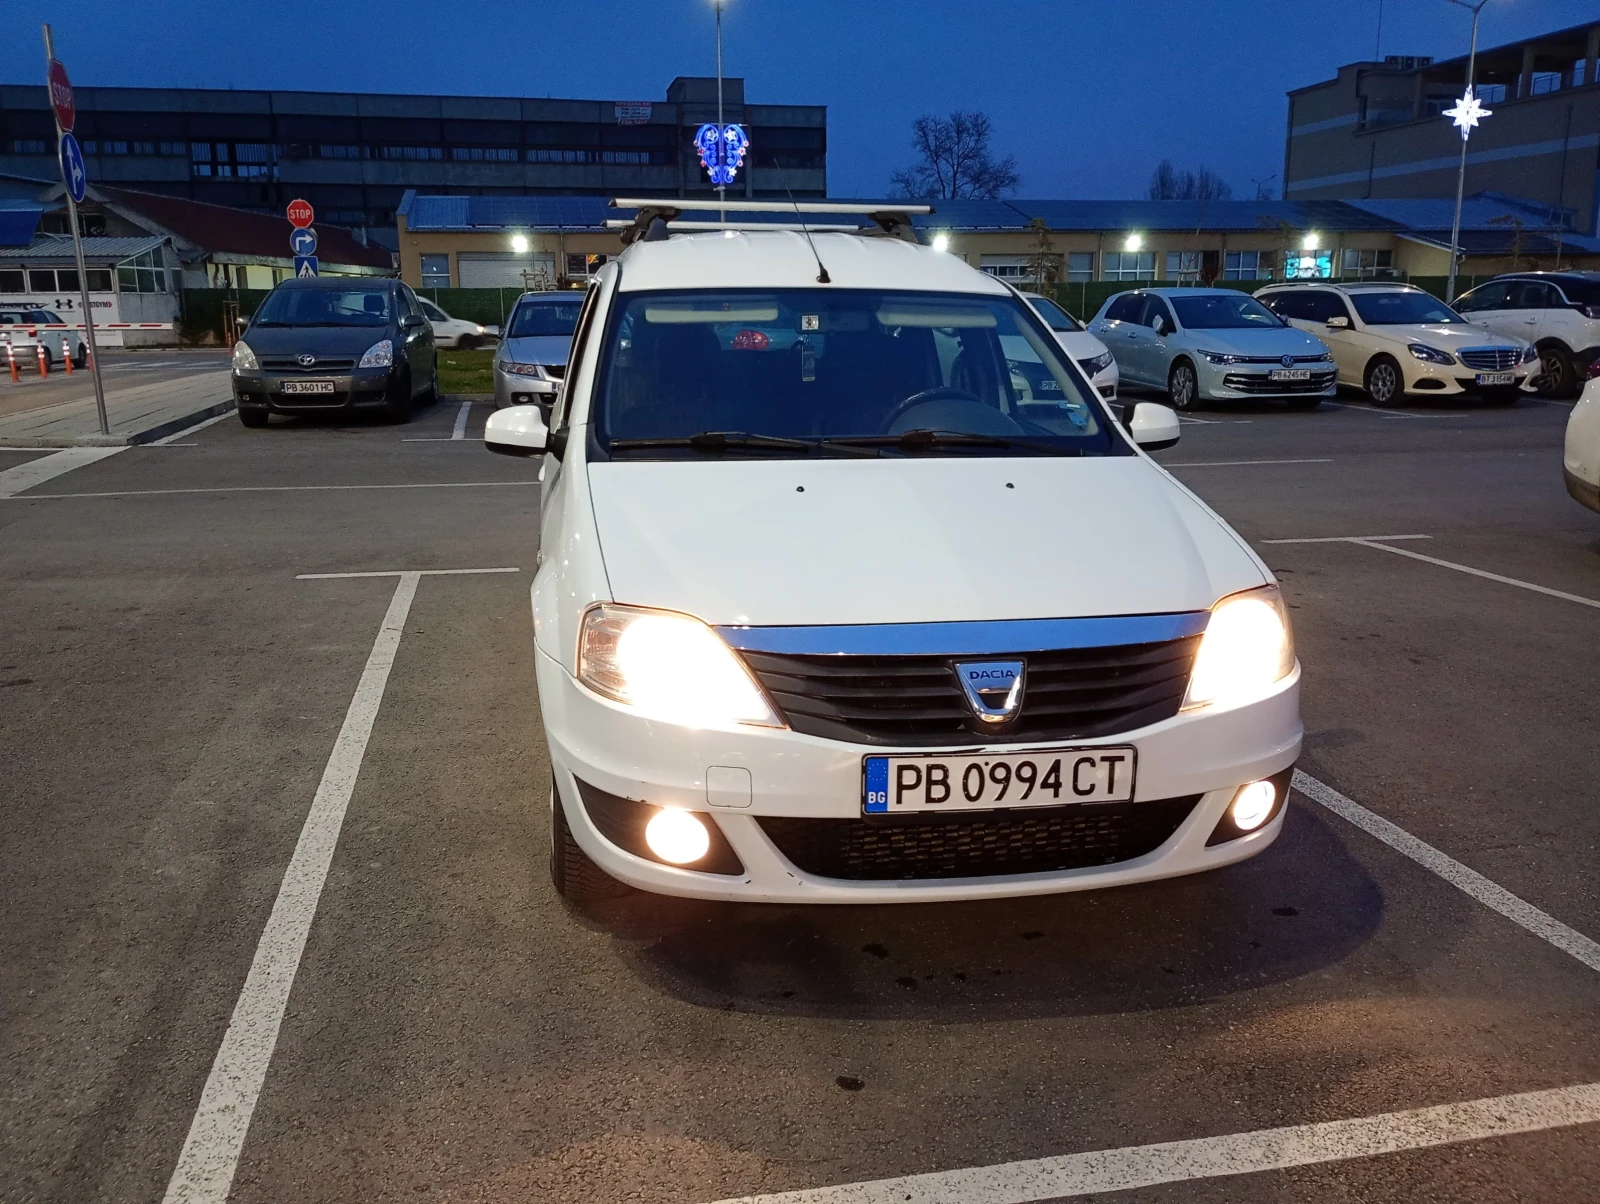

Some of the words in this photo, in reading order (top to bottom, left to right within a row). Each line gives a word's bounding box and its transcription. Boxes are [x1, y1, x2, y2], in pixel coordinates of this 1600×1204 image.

[53, 82, 71, 109] STOP
[290, 209, 310, 219] STOP
[286, 384, 298, 392] PB
[969, 670, 1016, 680] DACIA
[896, 763, 951, 804] PB
[962, 758, 1063, 803] 0994
[1072, 756, 1125, 796] CT
[868, 791, 886, 804] BG
